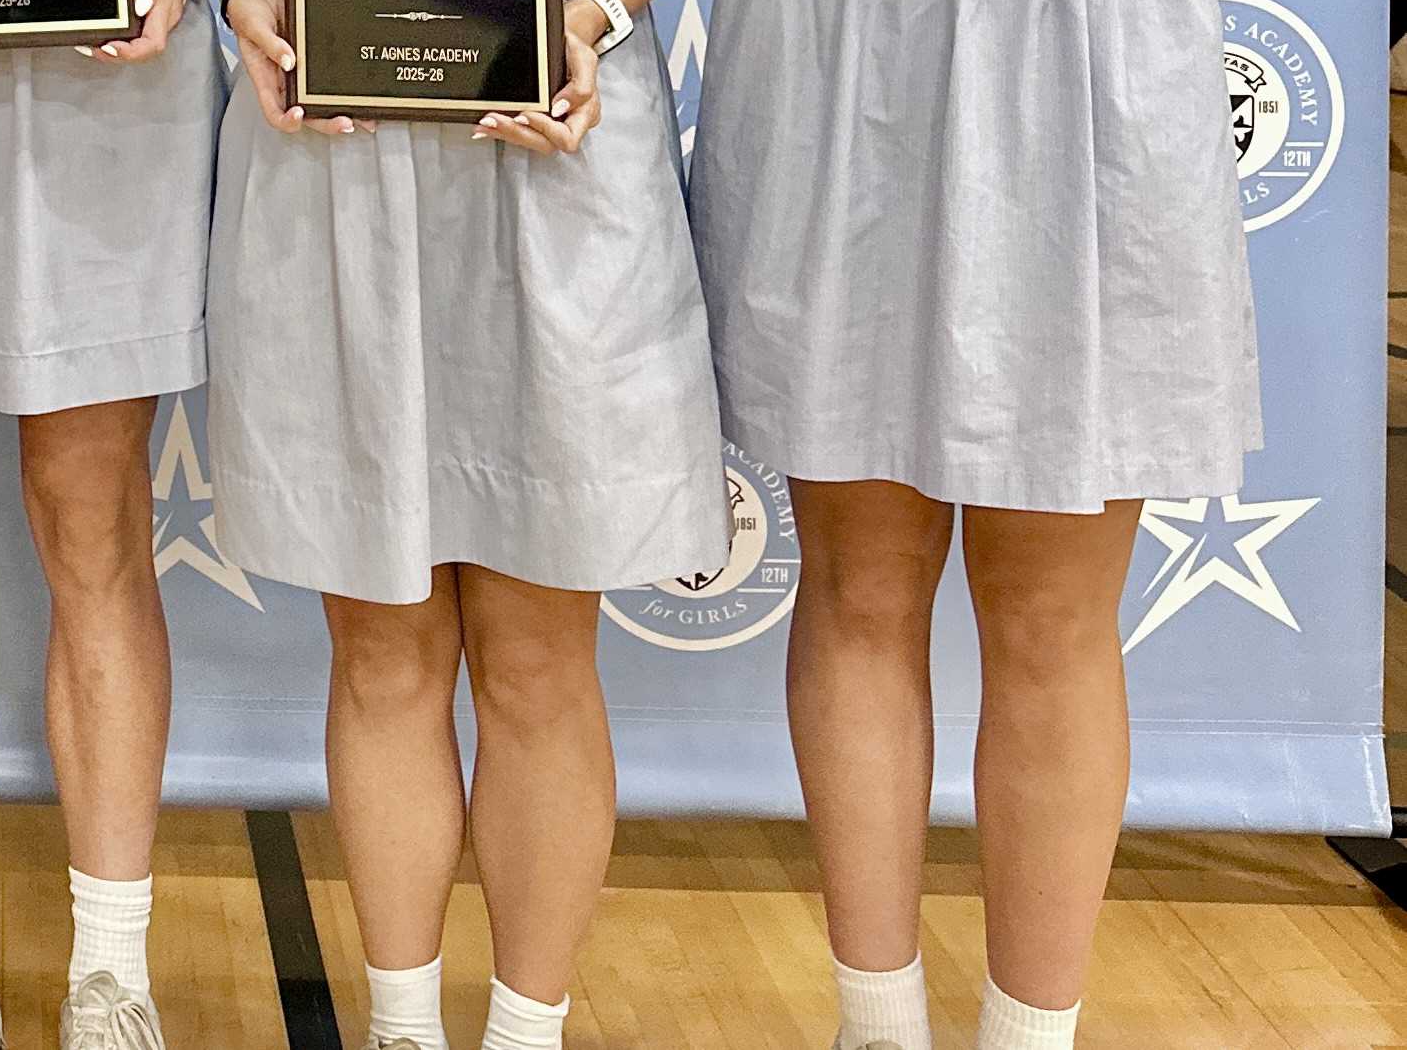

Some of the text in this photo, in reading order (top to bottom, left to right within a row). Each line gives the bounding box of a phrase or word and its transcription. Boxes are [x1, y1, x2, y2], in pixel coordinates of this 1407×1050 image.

[360, 46, 480, 63] ST. AGNES ACADEMY
[396, 67, 444, 82] 2025-26
[1244, 21, 1318, 126] ACADEMY
[1258, 100, 1279, 114] 1851
[1283, 150, 1311, 167] 12TH
[736, 517, 757, 531] 1851
[761, 567, 789, 584] 12TH
[638, 598, 748, 626] for GIRLS
